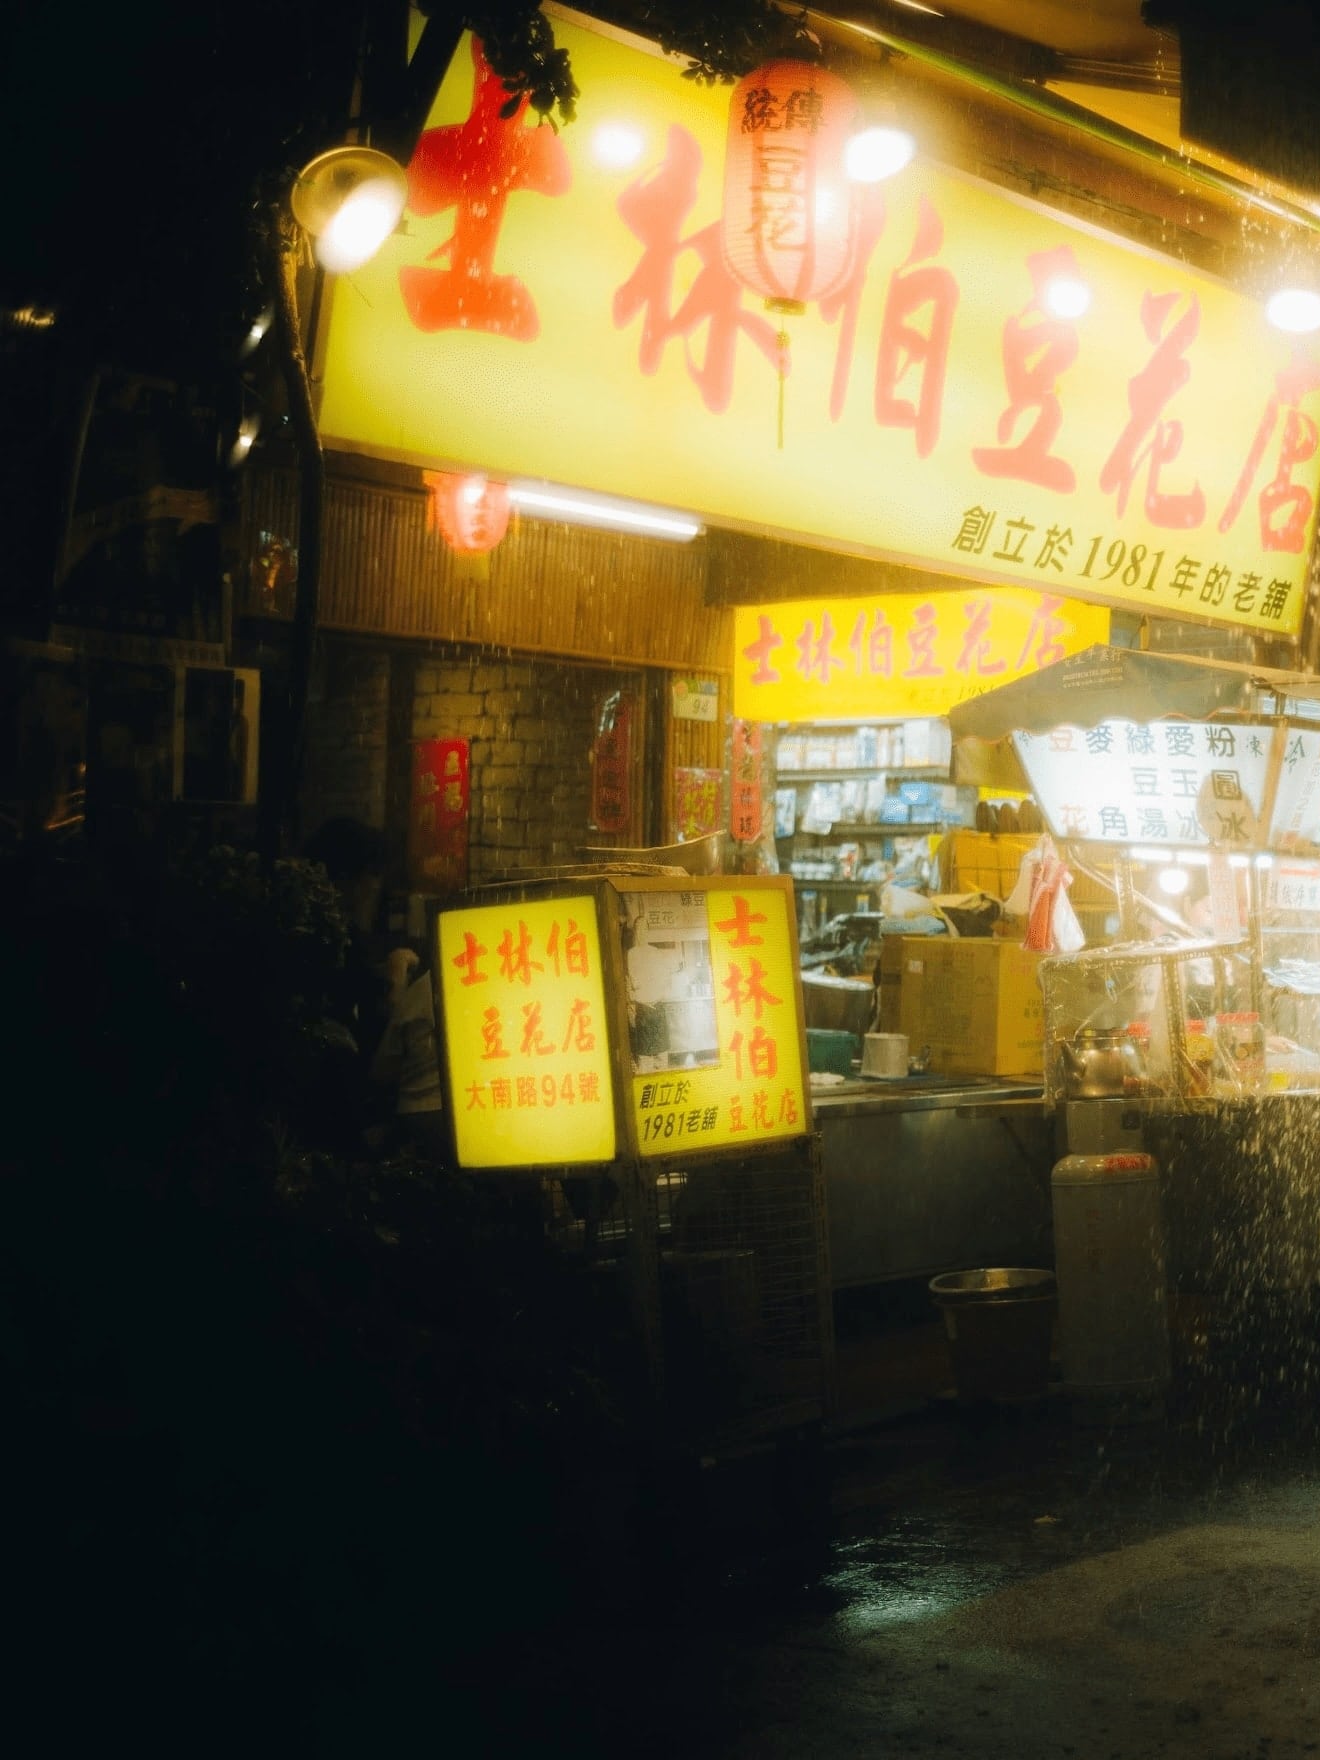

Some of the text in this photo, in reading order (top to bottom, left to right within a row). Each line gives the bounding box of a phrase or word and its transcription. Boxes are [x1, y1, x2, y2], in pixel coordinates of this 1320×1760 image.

[743, 592, 1066, 685] 士林伯豆花店
[1126, 724, 1171, 838] 綠豆湯
[1165, 724, 1211, 841] 愛玉冰
[1205, 726, 1249, 842] 粉圓冰
[452, 917, 590, 986] 士林伯
[714, 895, 783, 1081] 士林伯
[480, 998, 597, 1061] 豆花店
[465, 1071, 600, 1112] 大南路94號
[640, 1079, 692, 1110] 創立於
[728, 1087, 798, 1133] 豆花店
